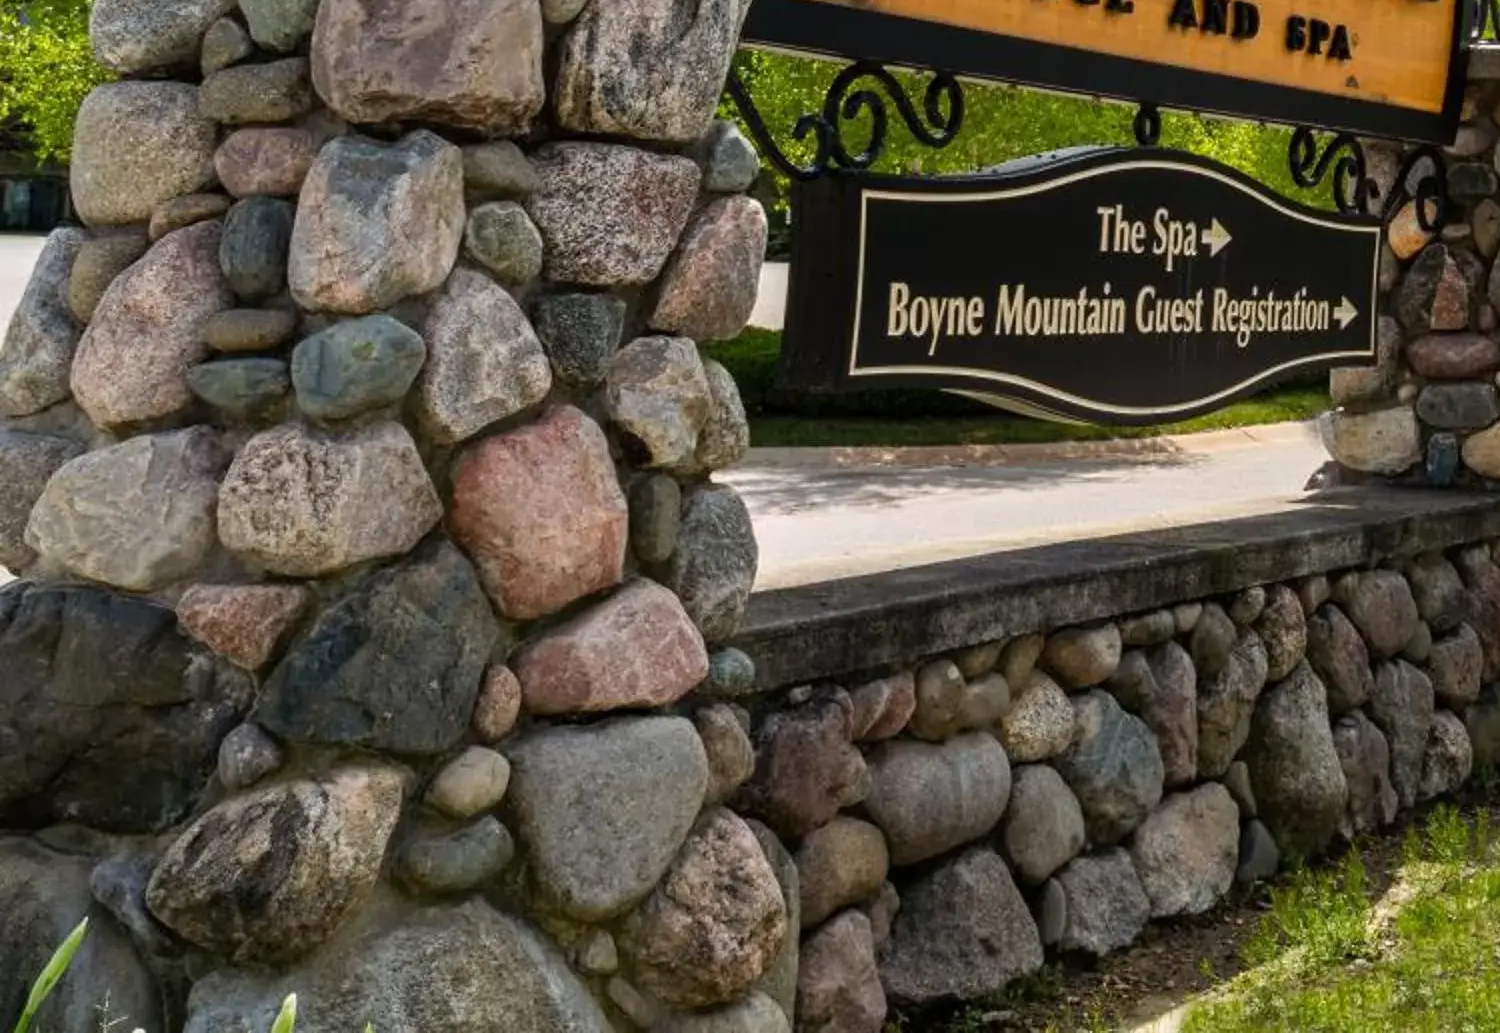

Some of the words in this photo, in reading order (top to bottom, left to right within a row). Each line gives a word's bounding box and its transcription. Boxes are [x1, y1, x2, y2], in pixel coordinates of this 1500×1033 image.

[1286, 13, 1353, 61] SPA
[1097, 205, 1145, 255] The
[1153, 206, 1198, 271] Spa
[888, 282, 983, 356] Boyne
[995, 283, 1125, 336] Mountain
[1135, 286, 1205, 334] Guest
[1211, 286, 1330, 347] Registration
